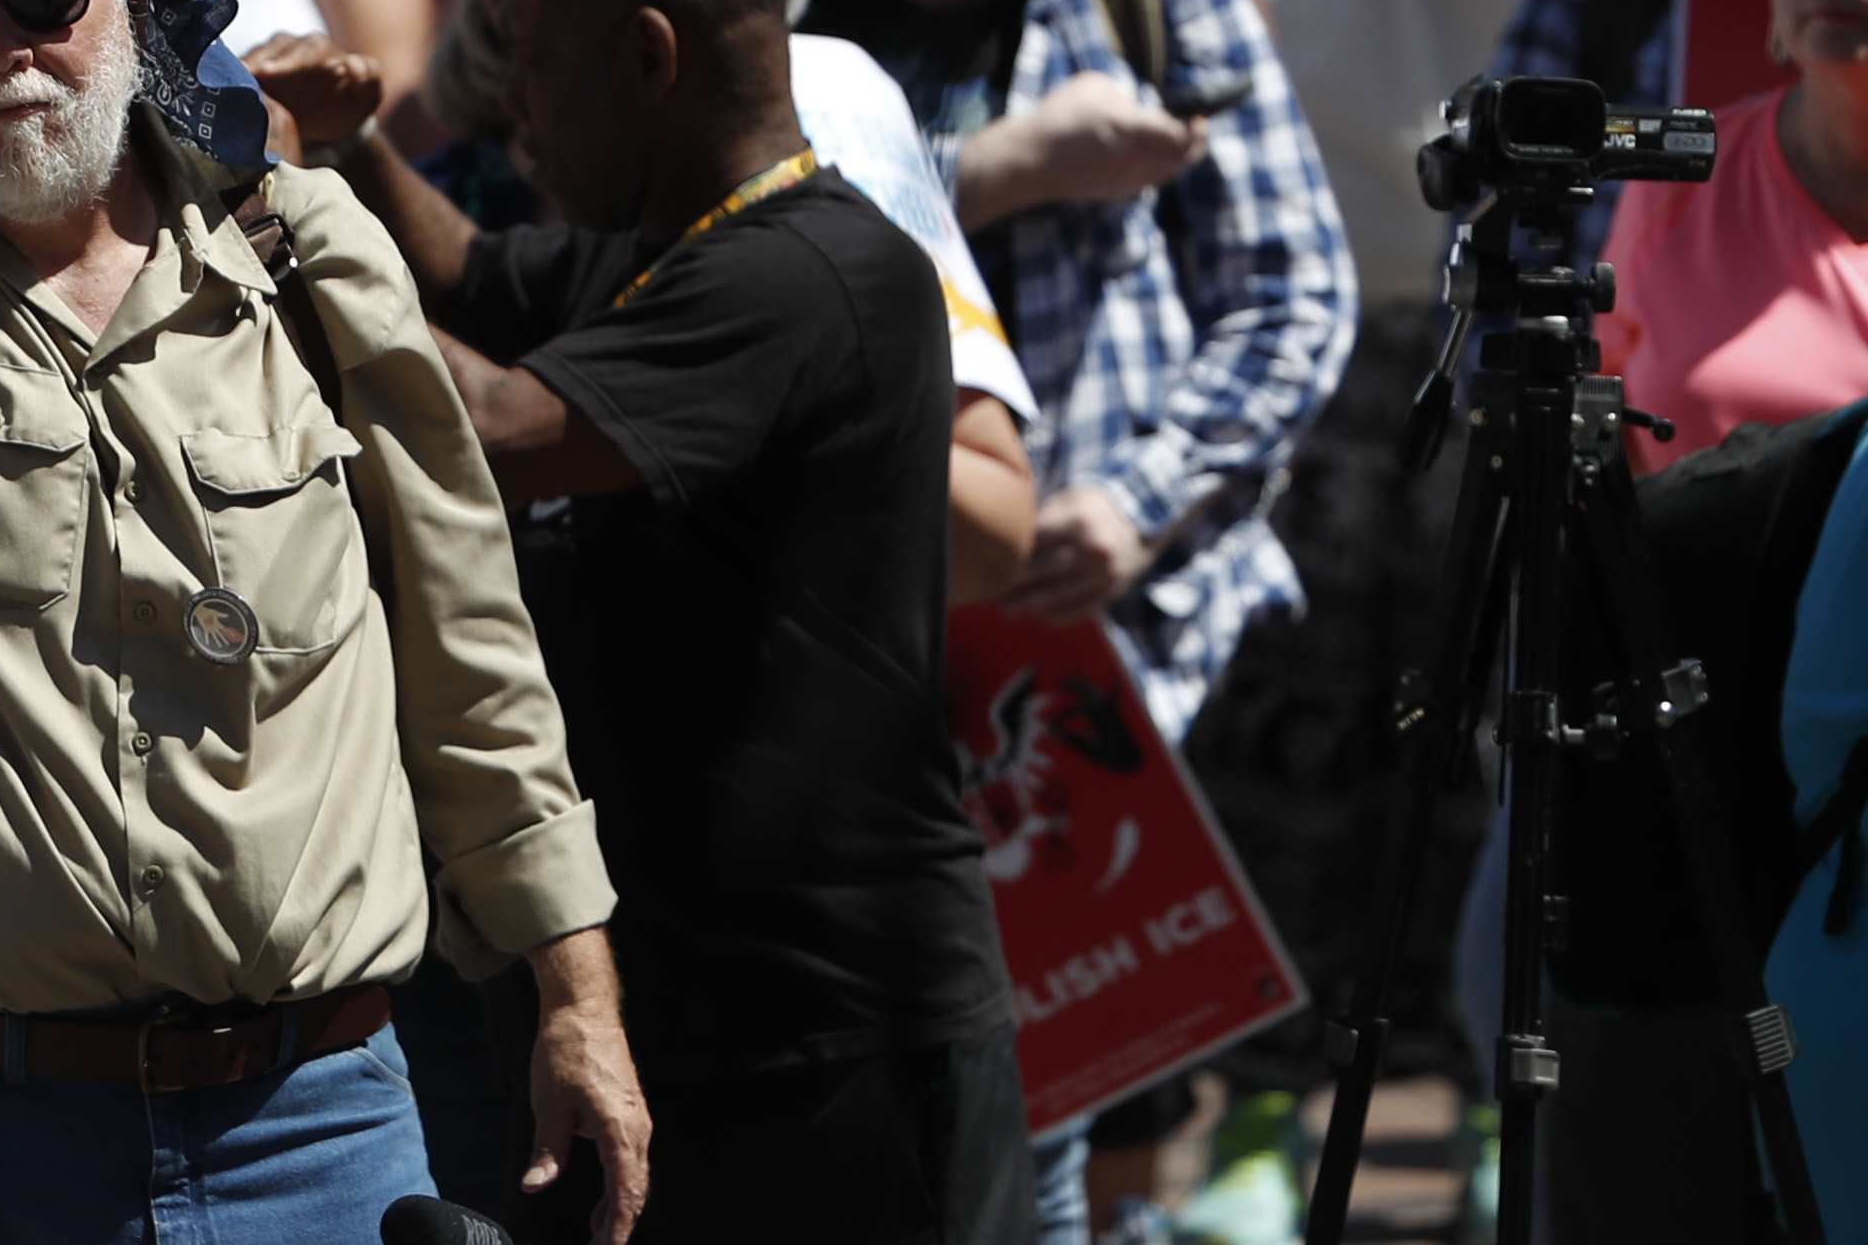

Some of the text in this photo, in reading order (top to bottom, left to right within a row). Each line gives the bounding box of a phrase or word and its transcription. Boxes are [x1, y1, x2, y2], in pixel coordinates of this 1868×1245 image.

[1603, 134, 1636, 149] JVC
[1012, 886, 1236, 1024] LISH ICE
